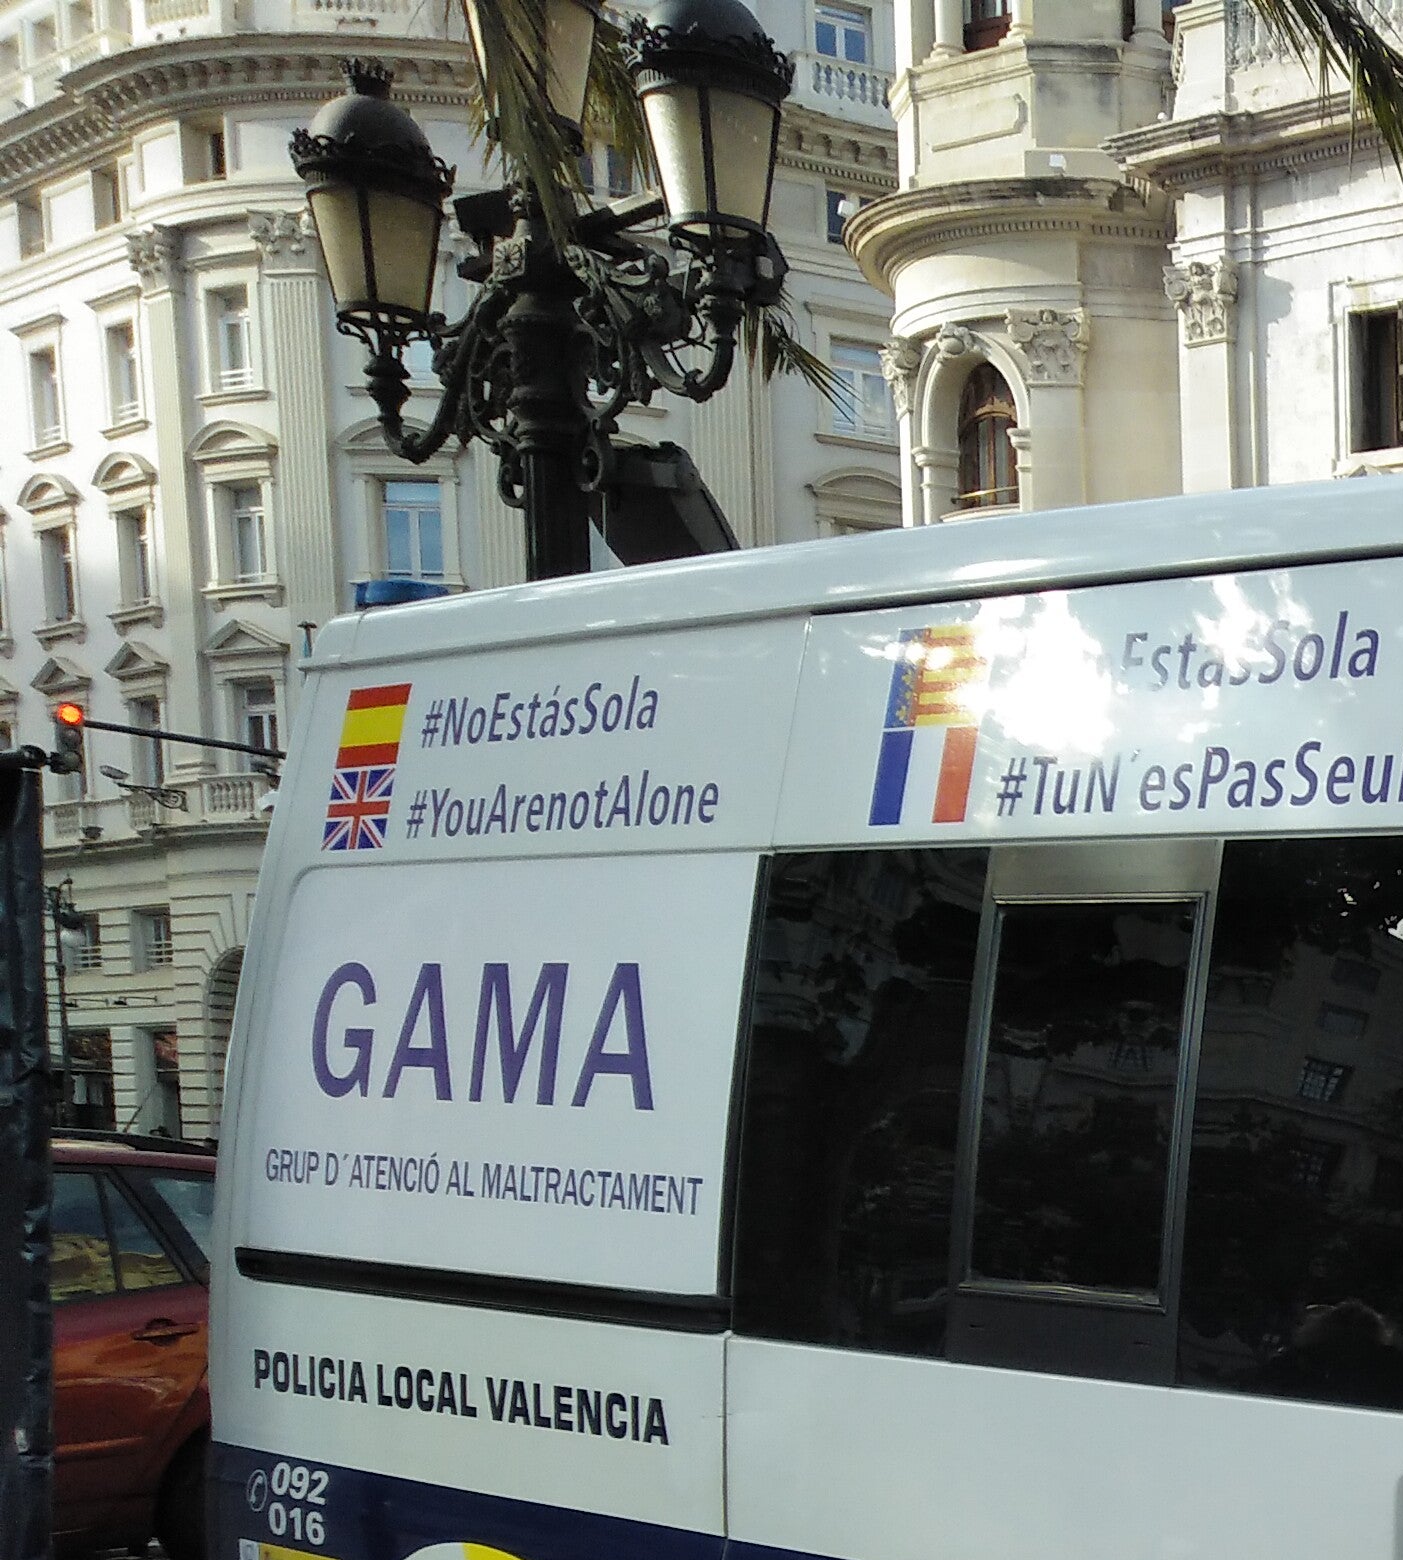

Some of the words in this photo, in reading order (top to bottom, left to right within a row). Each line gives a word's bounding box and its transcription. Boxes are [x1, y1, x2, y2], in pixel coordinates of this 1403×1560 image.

[420, 674, 659, 748] #NoEstásSola
[405, 769, 719, 839] #YouArenotAlone
[311, 961, 655, 1112] GAMA
[264, 1149, 320, 1185] GRUP
[445, 1167, 475, 1199] AL
[481, 1163, 703, 1217] MALTRACTAMENT
[253, 1347, 369, 1404] POLICIA
[376, 1362, 478, 1418] LOCAL
[484, 1375, 670, 1447] VALENCIA
[270, 1460, 330, 1506] 092
[267, 1501, 326, 1547] 016
